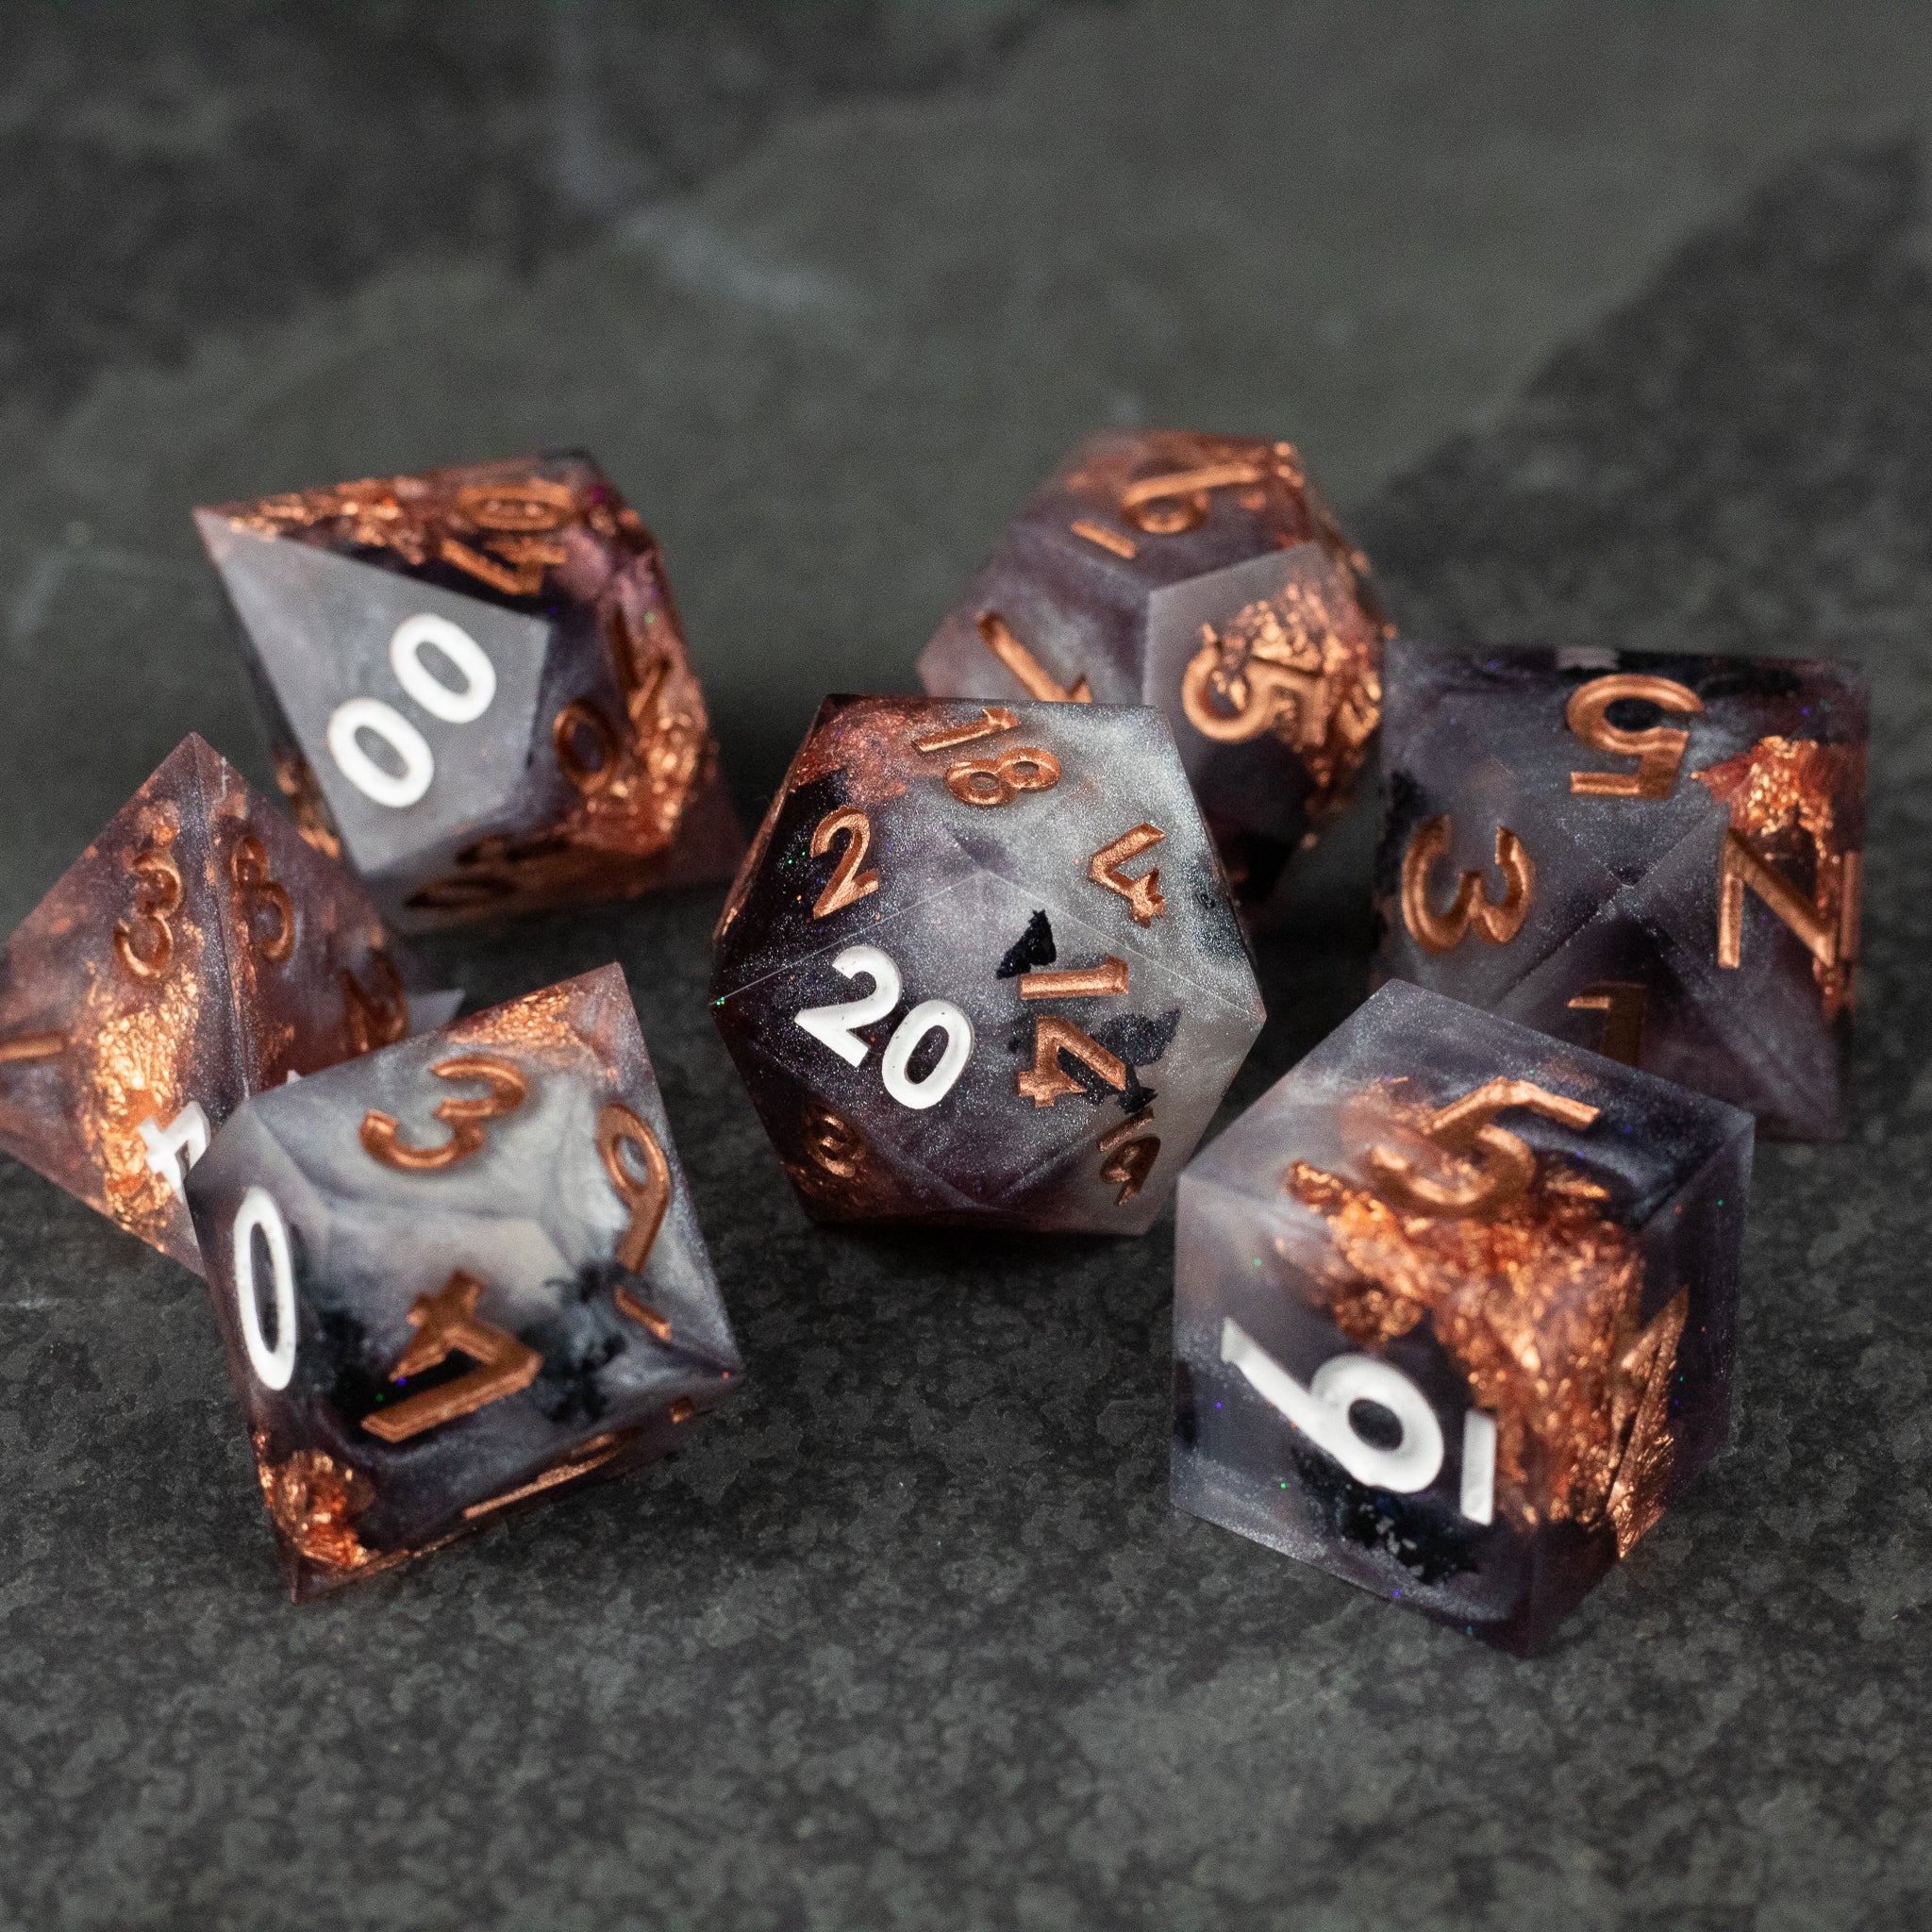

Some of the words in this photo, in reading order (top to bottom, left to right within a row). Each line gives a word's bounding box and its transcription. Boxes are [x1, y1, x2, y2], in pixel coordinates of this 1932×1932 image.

[314, 613, 497, 808] 00
[911, 709, 1062, 807] 18
[1567, 674, 1704, 800] 5
[112, 846, 183, 989] 3
[810, 805, 878, 919] 2
[1089, 822, 1167, 928] 4
[1402, 814, 1537, 955] 3
[794, 945, 975, 1110] 20
[1016, 955, 1131, 1108] 14
[359, 1056, 528, 1174] 3
[232, 1187, 297, 1391] 0
[359, 1271, 543, 1443] 4
